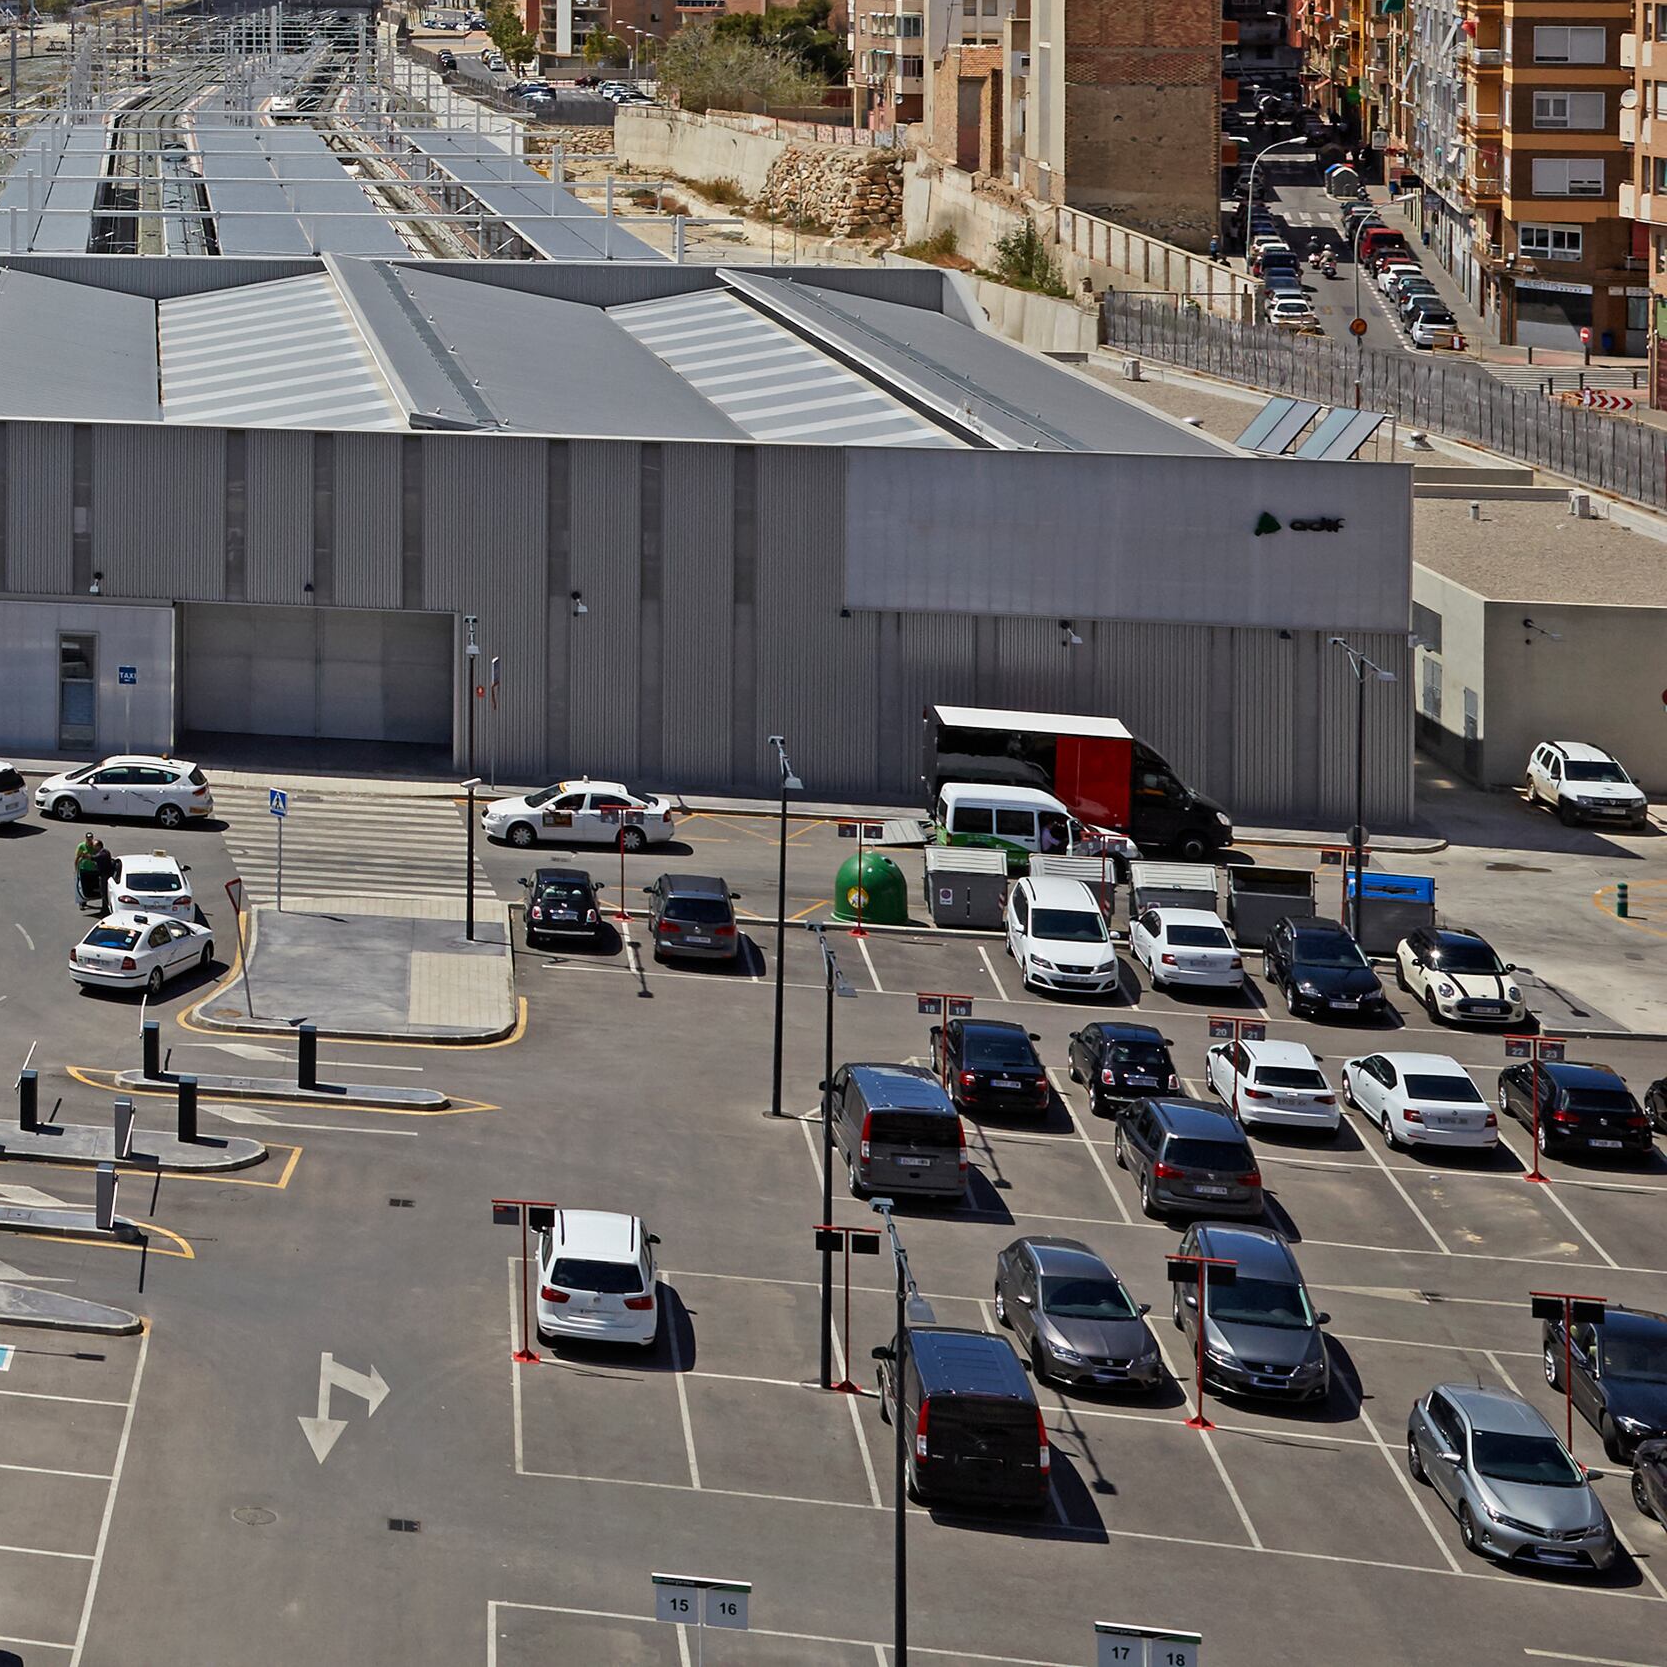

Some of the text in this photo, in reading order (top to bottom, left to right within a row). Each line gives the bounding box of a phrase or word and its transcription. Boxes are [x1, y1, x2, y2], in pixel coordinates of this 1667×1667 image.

[1290, 517, 1346, 532] adif
[924, 1004, 935, 1013] 18
[955, 1007, 966, 1015] 19
[1215, 1028, 1227, 1037] 20
[1248, 1031, 1259, 1039] 21
[1512, 1047, 1524, 1056] 22
[1546, 1050, 1557, 1058] 23
[670, 1598, 689, 1612] 15
[720, 1602, 738, 1616] 16
[1112, 1646, 1131, 1661] 17
[1166, 1652, 1186, 1667] 18
